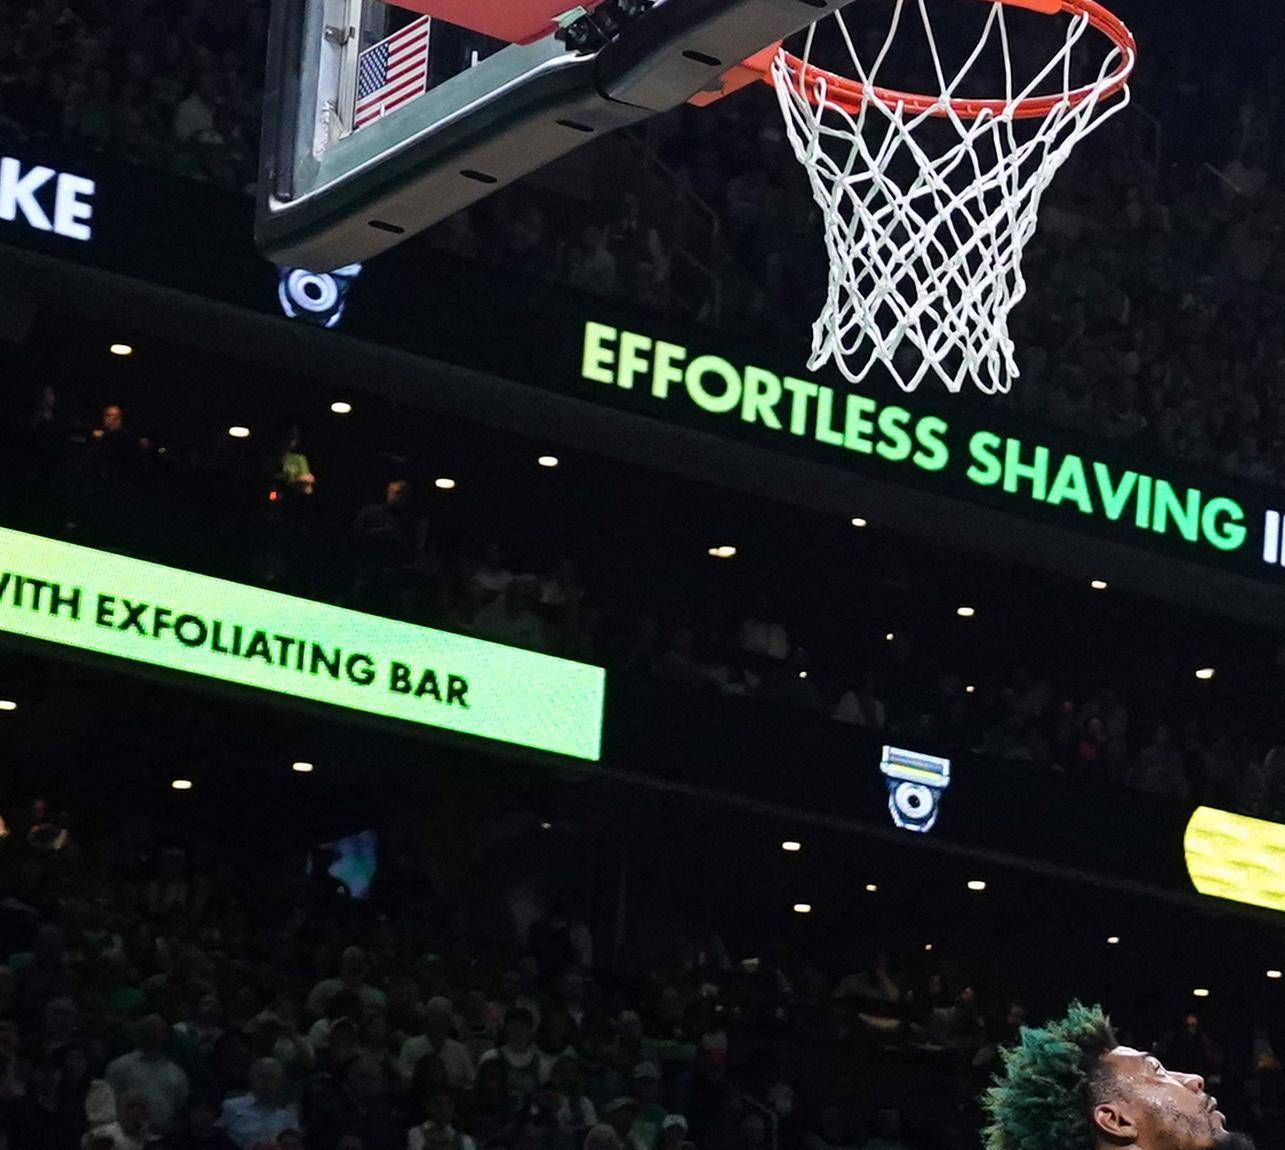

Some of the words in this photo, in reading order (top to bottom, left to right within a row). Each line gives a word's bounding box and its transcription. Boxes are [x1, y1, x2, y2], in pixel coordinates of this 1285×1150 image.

[581, 321, 949, 470] EFFORTLESS
[966, 430, 1247, 551] SHAVING
[97, 594, 376, 687] EXFOLIATING
[389, 662, 471, 709] BAR
